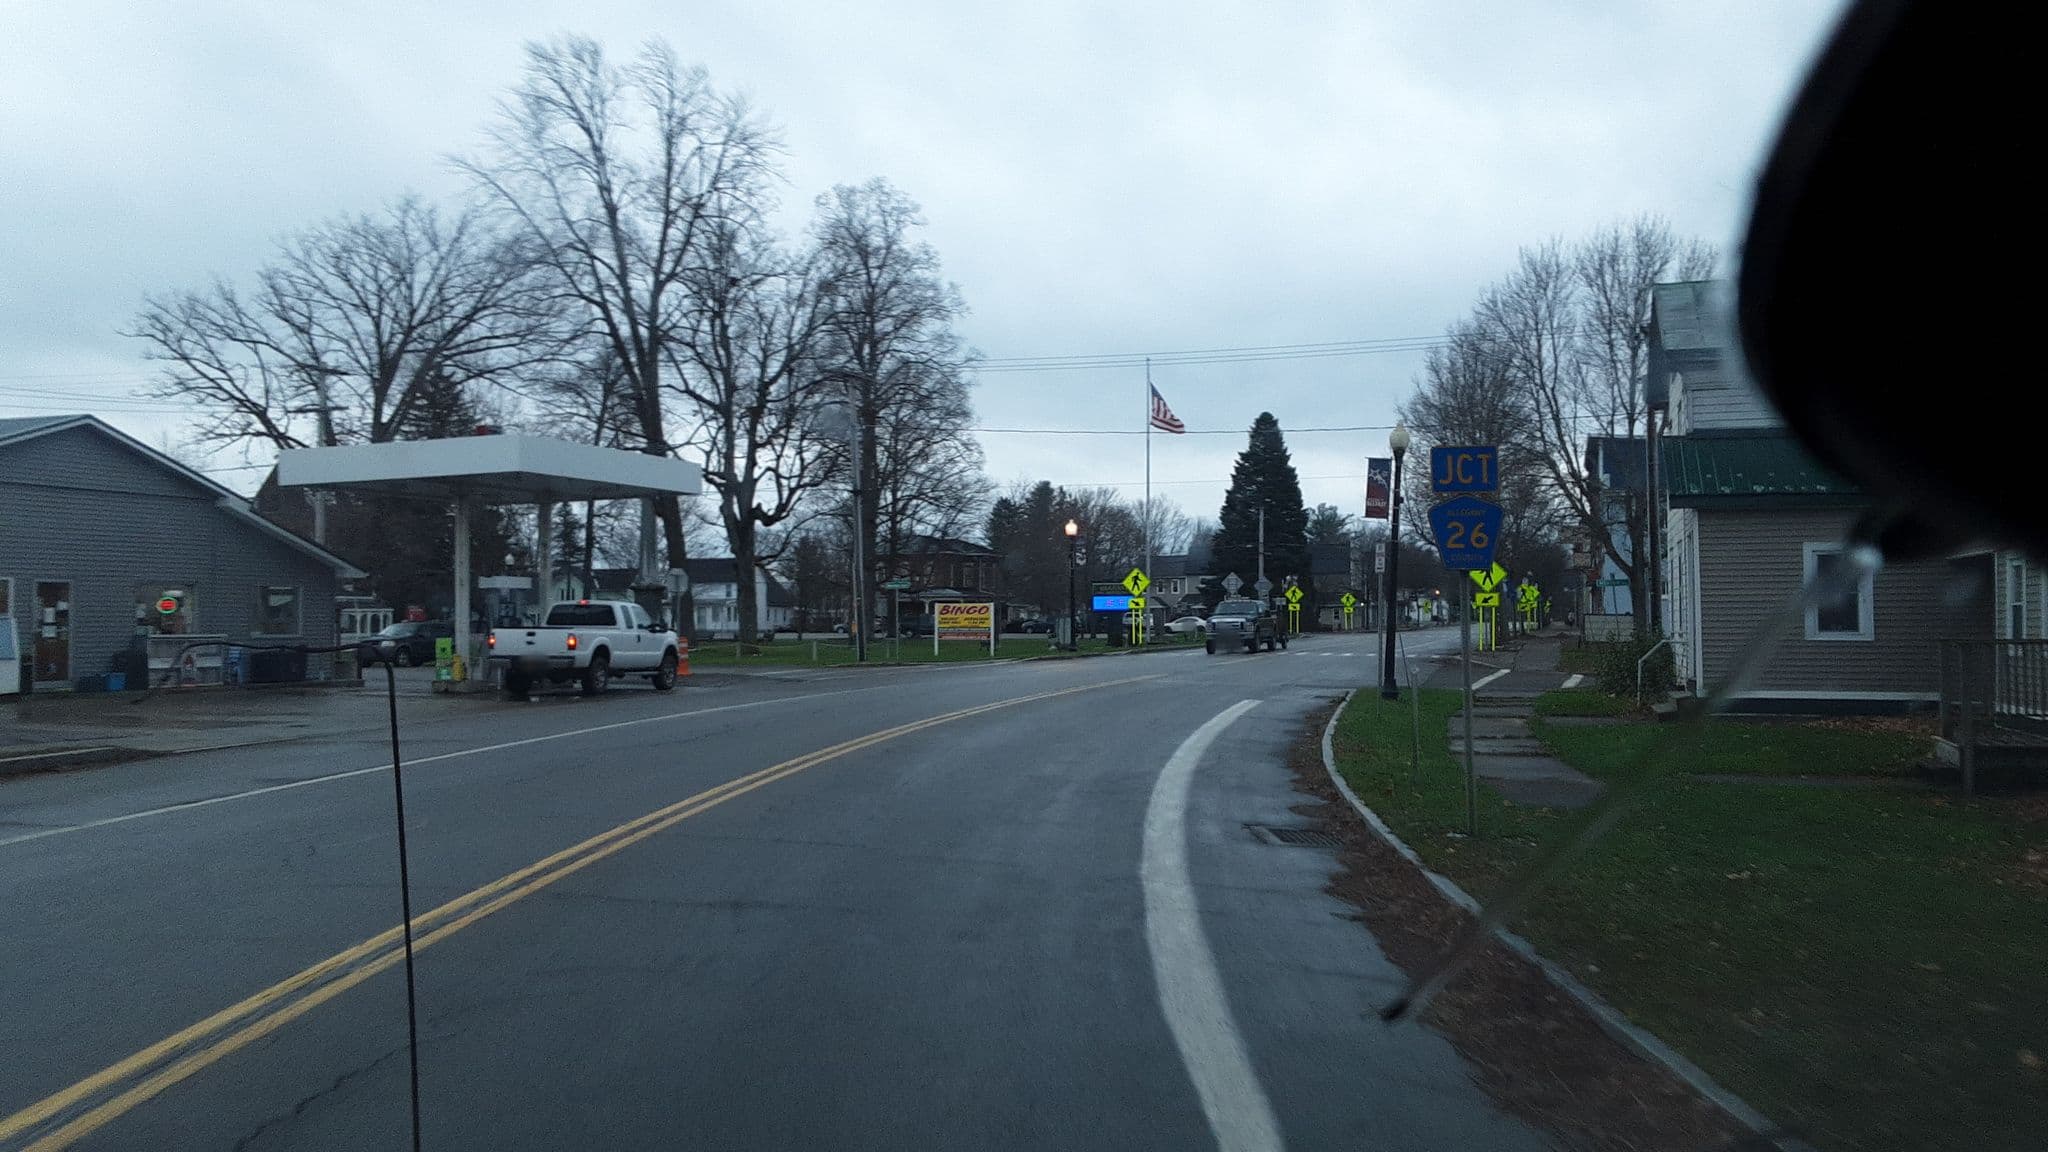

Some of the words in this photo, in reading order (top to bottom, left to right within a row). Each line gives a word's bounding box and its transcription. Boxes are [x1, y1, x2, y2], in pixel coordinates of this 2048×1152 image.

[1440, 453, 1491, 484] JCT
[1446, 521, 1488, 548] 26
[939, 604, 990, 615] BINGO
